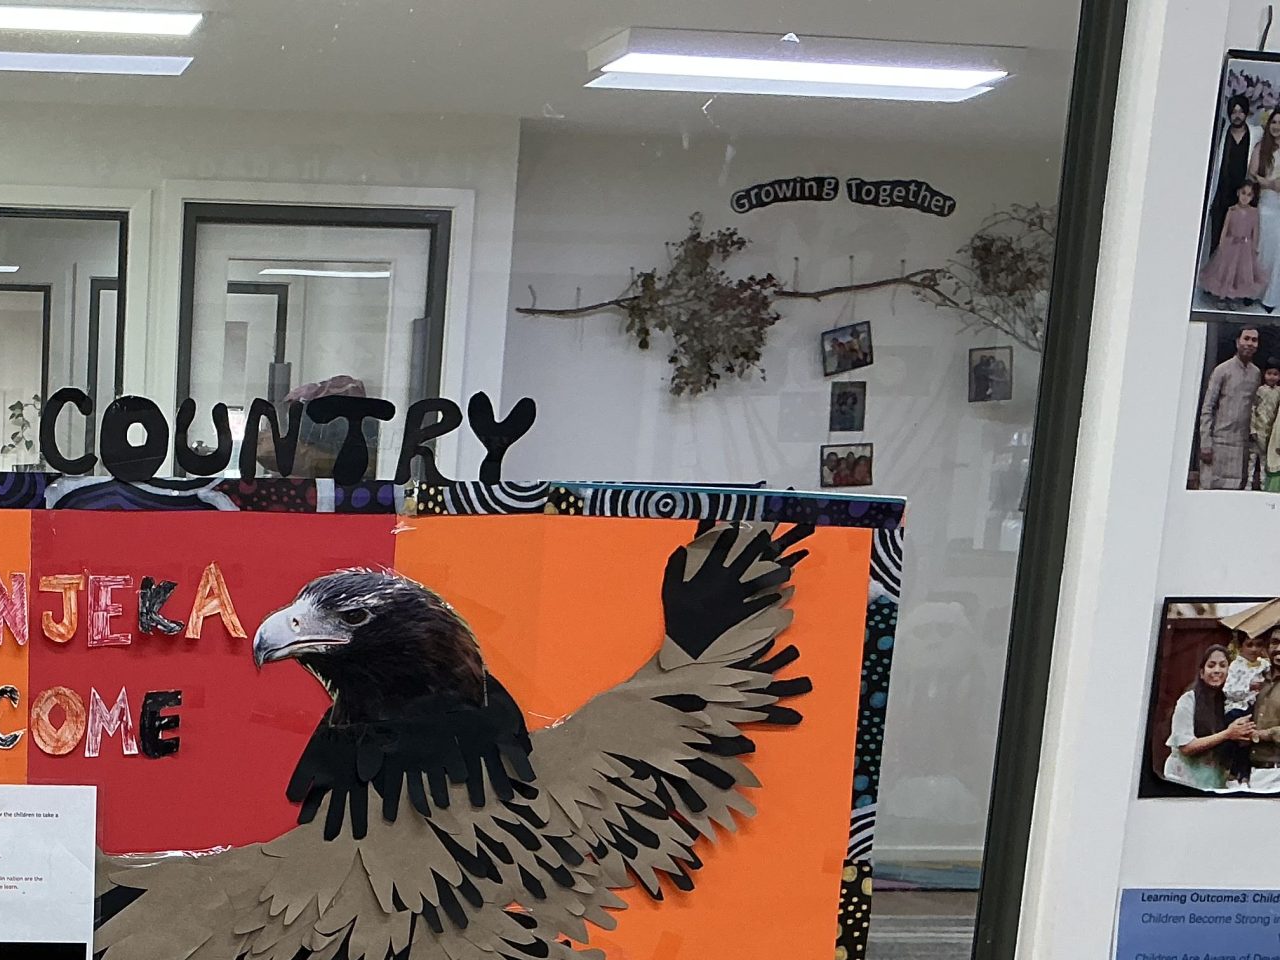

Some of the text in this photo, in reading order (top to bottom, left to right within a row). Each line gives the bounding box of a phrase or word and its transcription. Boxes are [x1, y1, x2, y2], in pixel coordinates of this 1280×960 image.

[732, 176, 954, 215] Growing Together
[40, 387, 536, 485] COUNTRY
[1141, 892, 1187, 904] Learning
[1141, 912, 1186, 924] Children
[1188, 912, 1233, 924] Become
[1234, 913, 1271, 926] Strong
